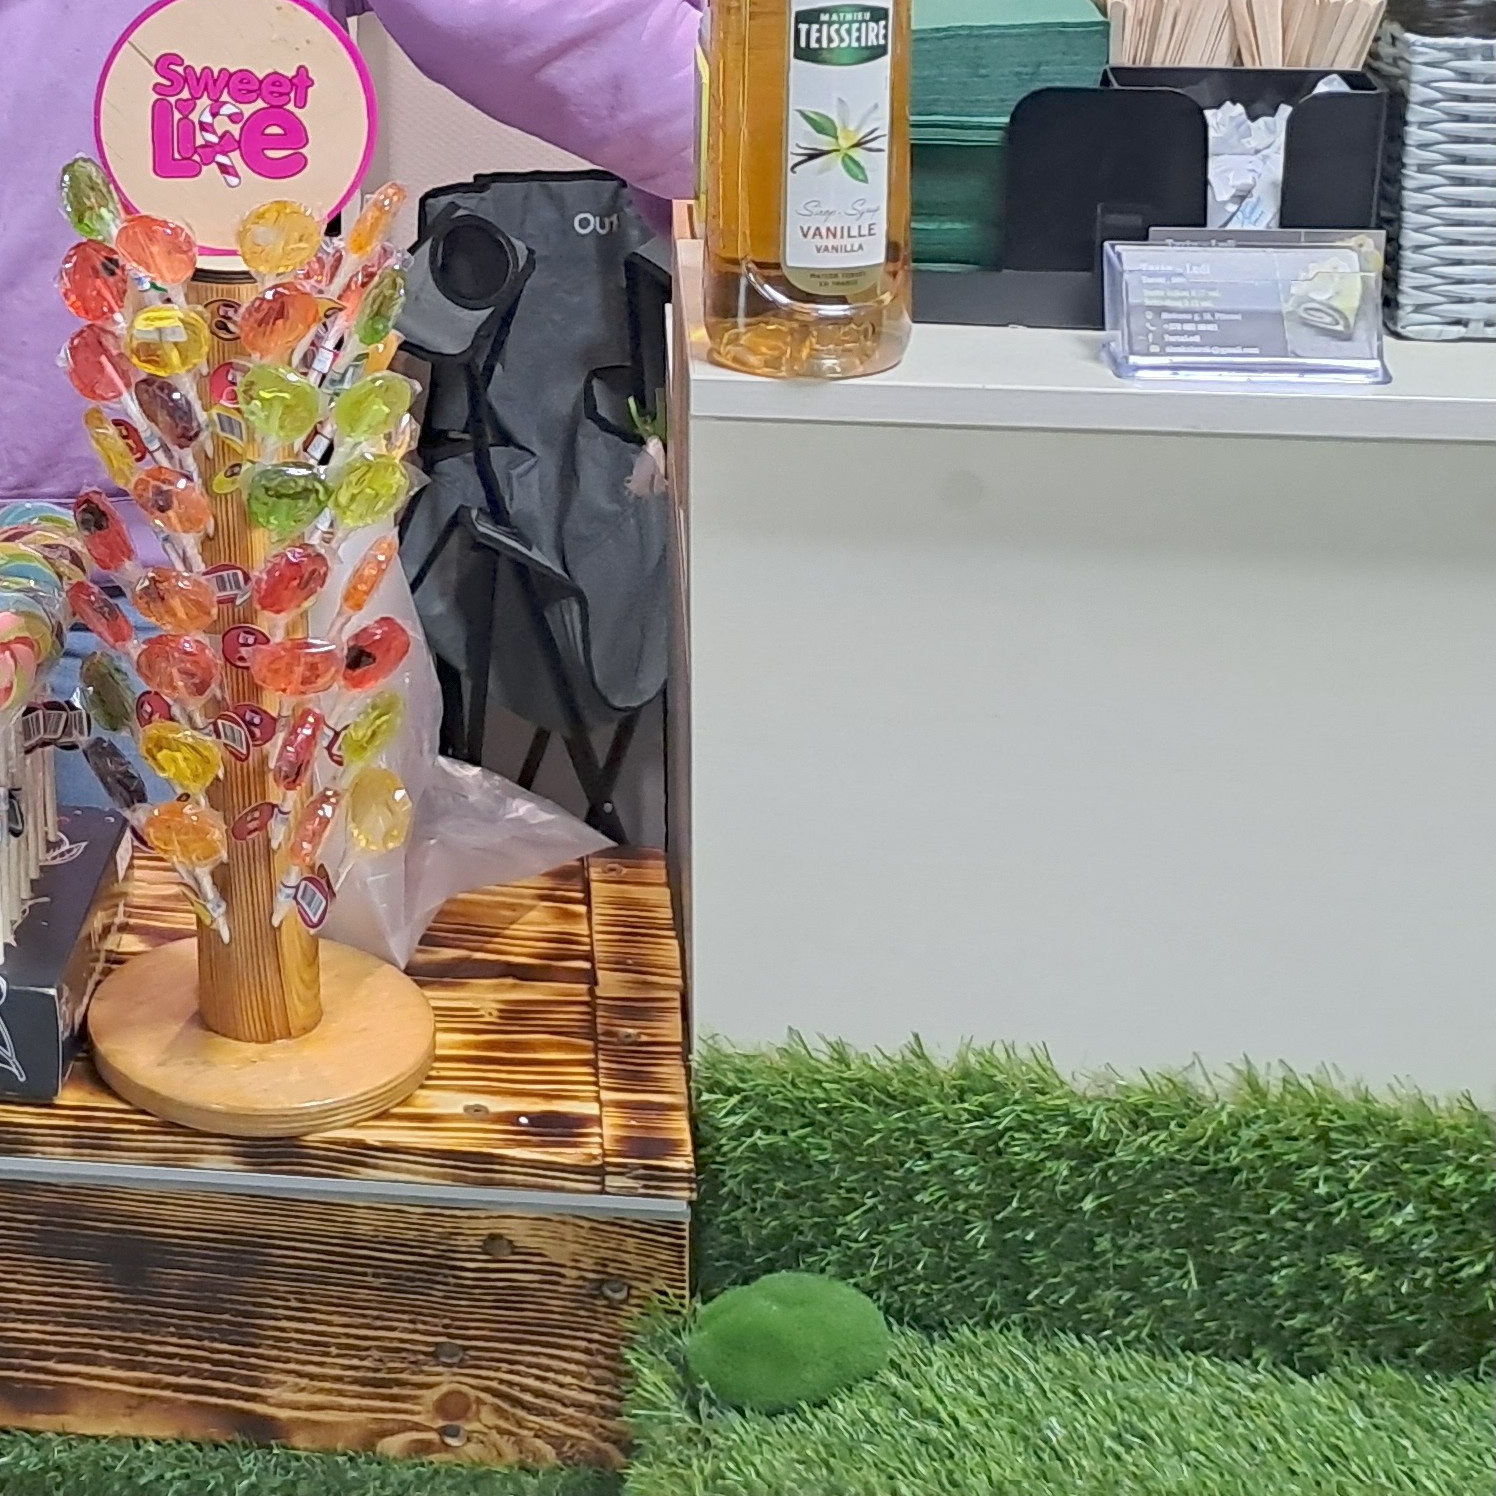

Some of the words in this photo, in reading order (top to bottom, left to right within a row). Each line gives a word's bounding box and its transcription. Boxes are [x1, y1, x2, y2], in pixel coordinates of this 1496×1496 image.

[819, 11, 871, 22] MATHIEU
[797, 20, 887, 49] TEISSEIRE
[152, 52, 314, 109] Sweet
[151, 98, 310, 188] Life
[799, 222, 878, 240] VANILLE
[815, 243, 865, 254] VANILLA
